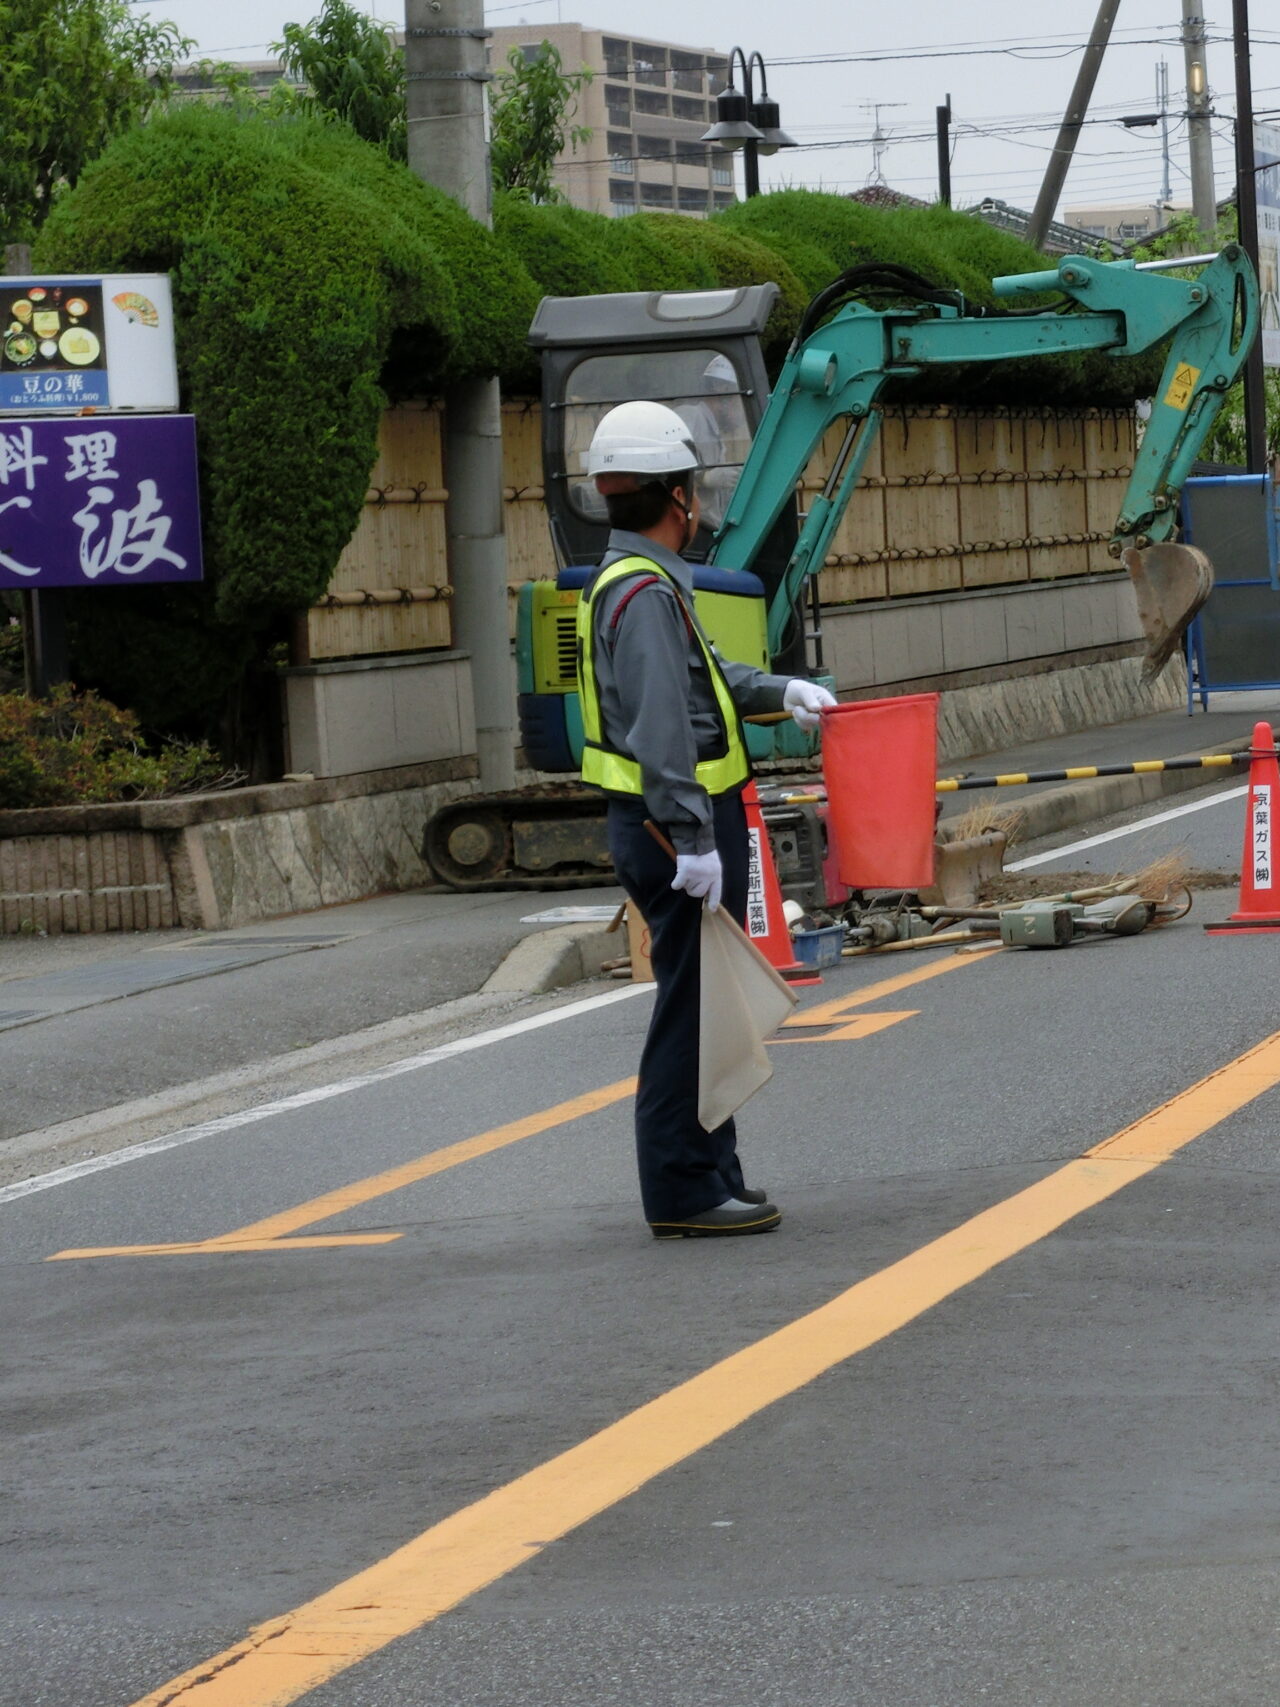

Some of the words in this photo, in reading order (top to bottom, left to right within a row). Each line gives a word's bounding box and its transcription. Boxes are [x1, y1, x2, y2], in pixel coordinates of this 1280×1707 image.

[23, 374, 83, 393] 豆の華
[1255, 792, 1270, 883] 京葉ガス㈱
